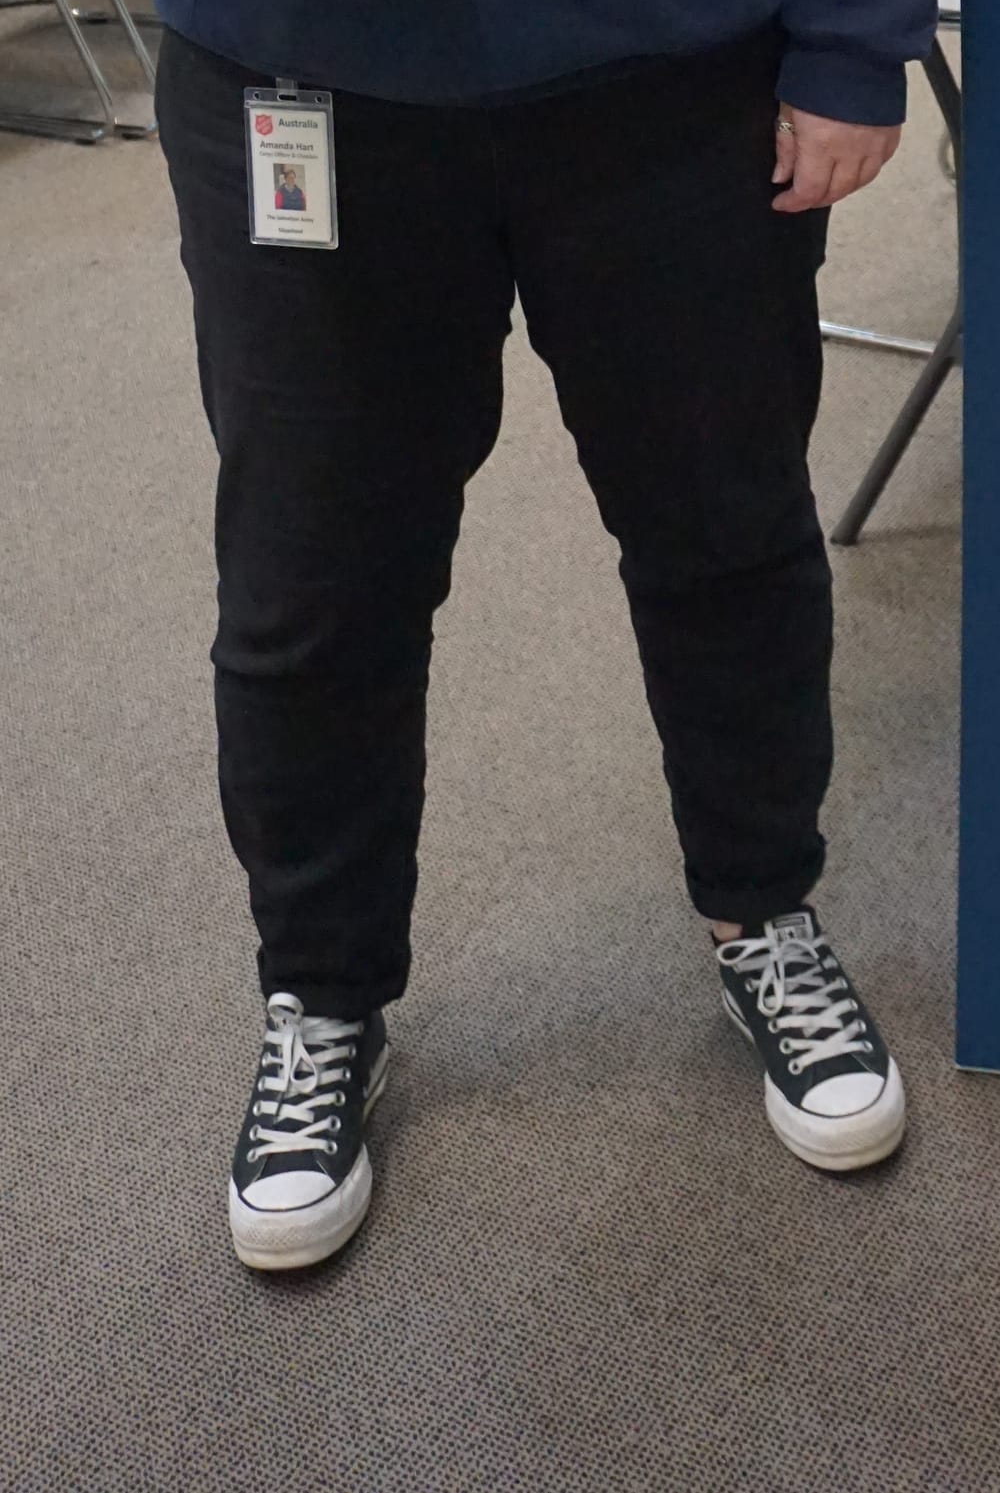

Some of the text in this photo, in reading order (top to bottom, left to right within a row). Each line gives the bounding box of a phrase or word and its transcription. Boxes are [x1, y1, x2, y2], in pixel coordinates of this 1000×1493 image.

[278, 118, 318, 128] Australia
[260, 140, 314, 151] Amanda Hart
